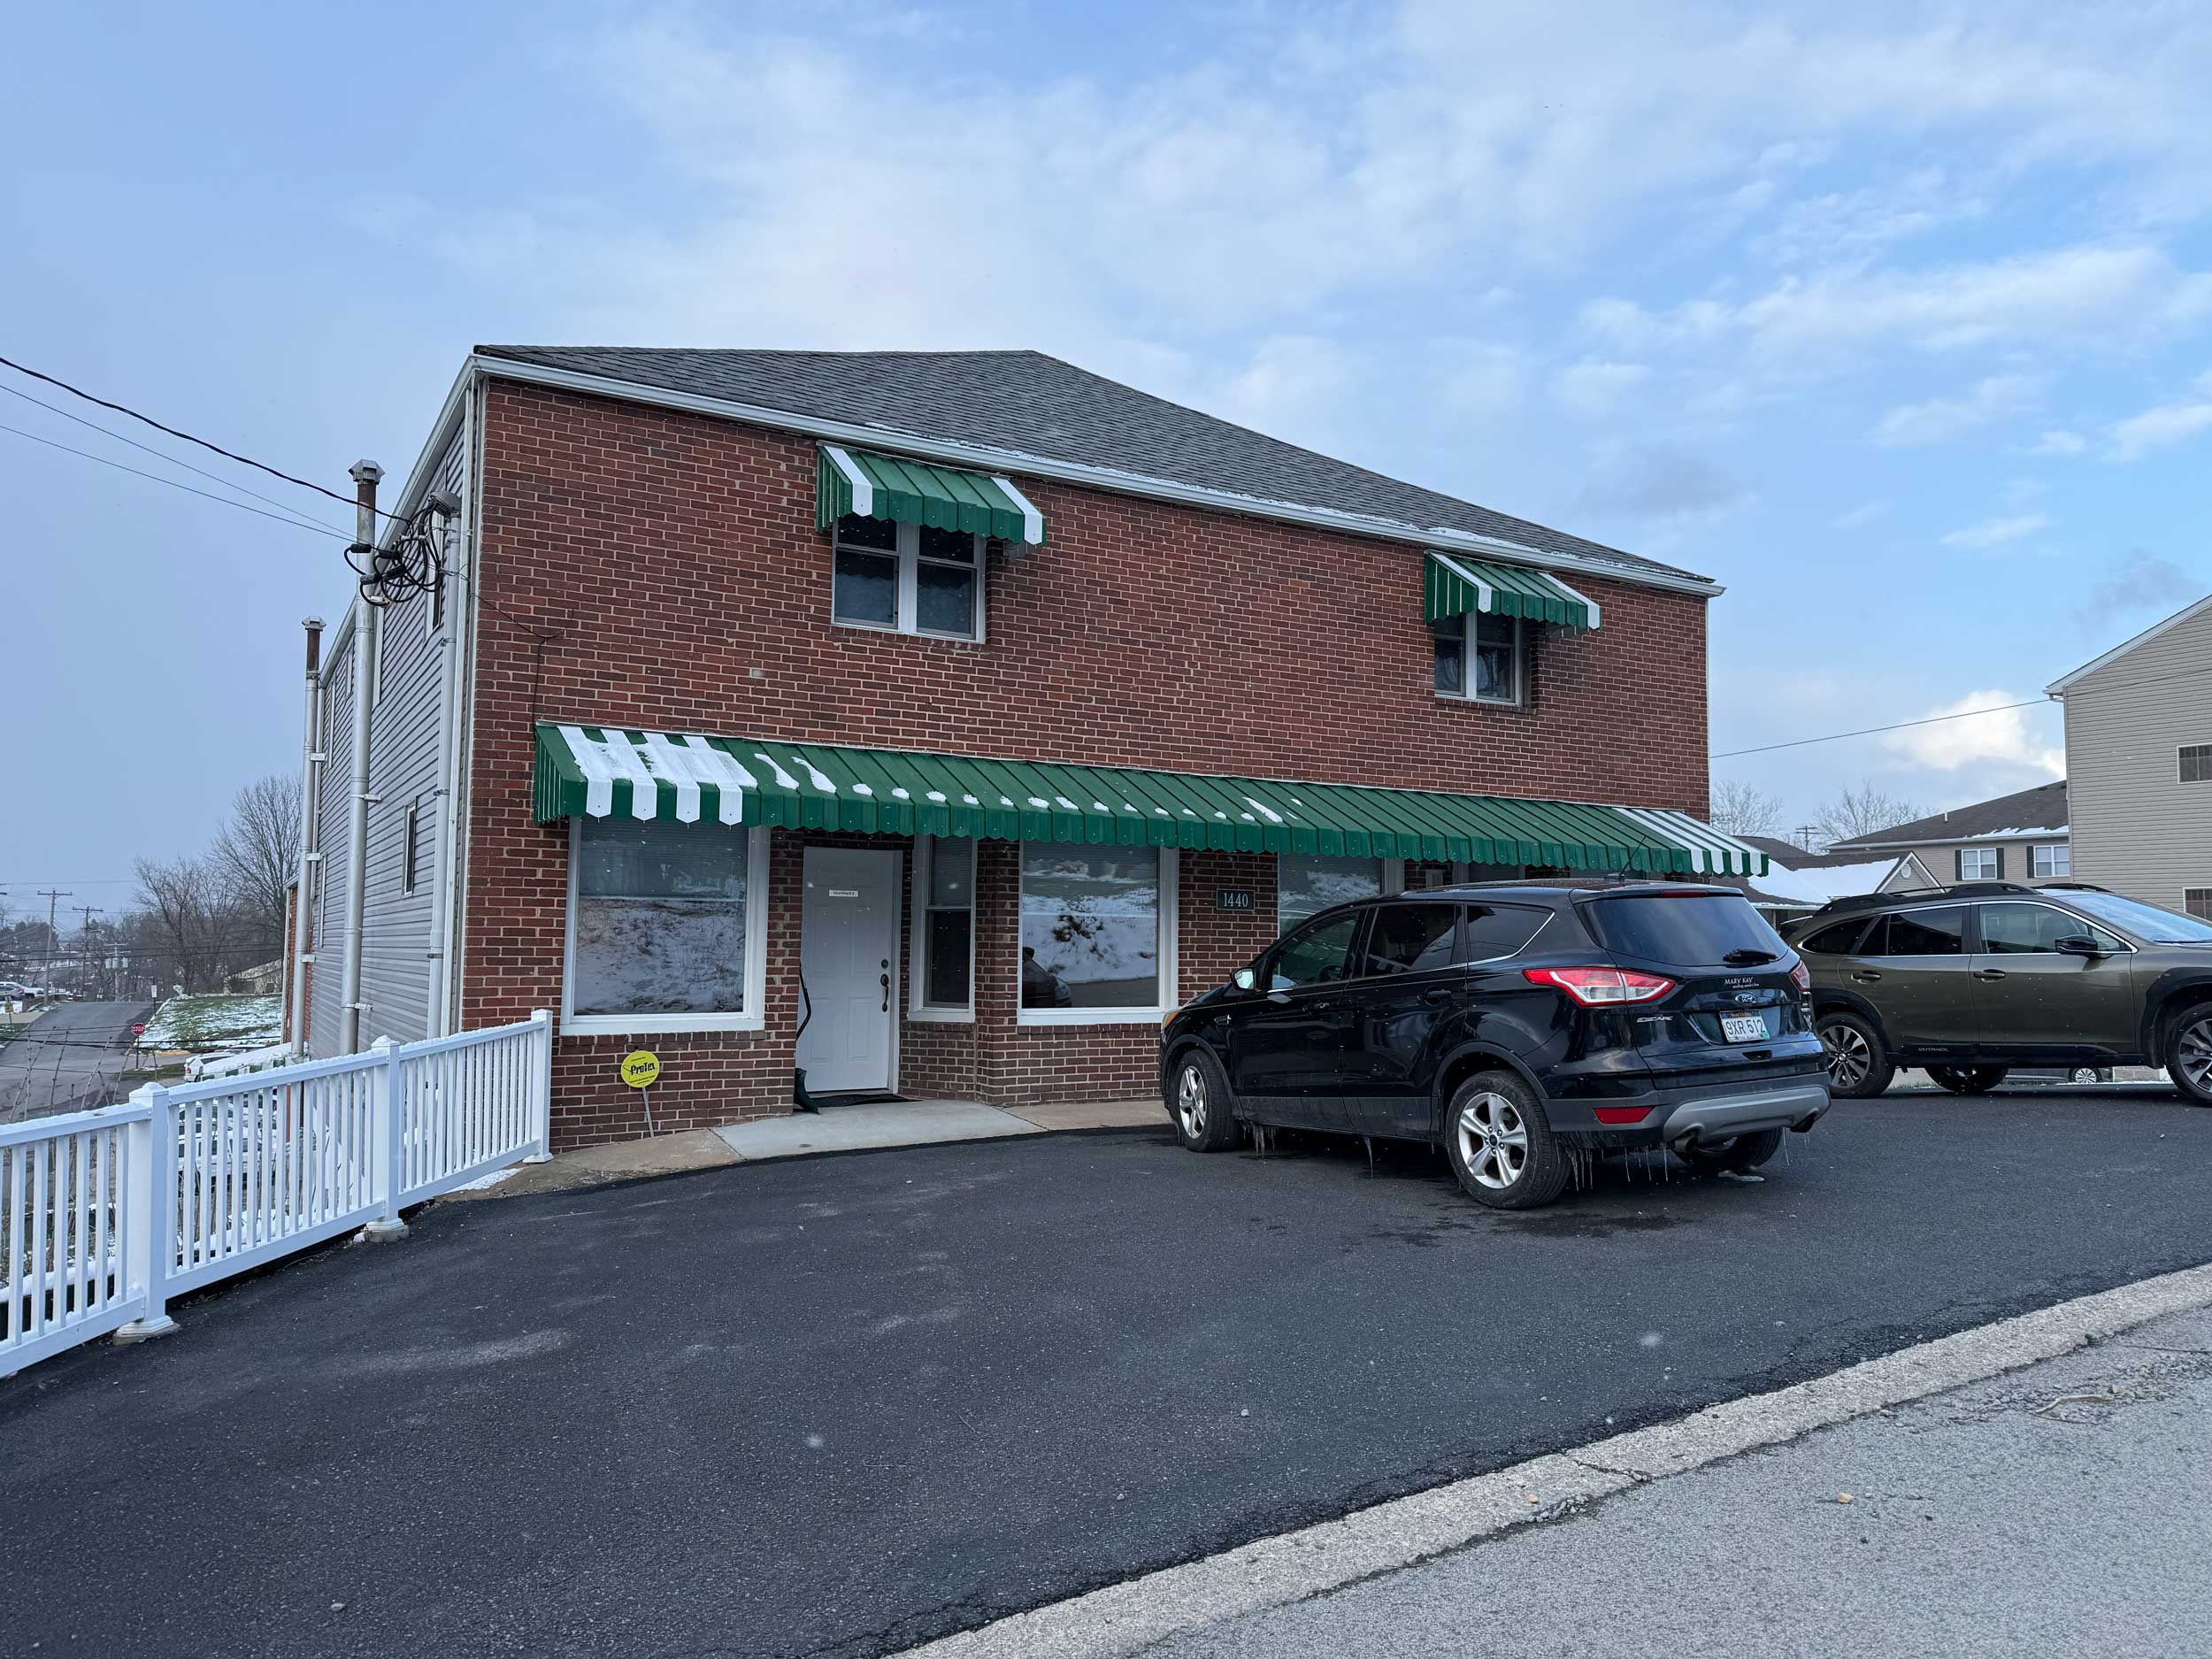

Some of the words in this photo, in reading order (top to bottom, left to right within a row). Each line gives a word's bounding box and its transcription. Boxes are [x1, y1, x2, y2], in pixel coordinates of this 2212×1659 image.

[1224, 893, 1248, 907] 1440
[1725, 1020, 1746, 1035] 9XR
[1746, 1019, 1765, 1033] 512
